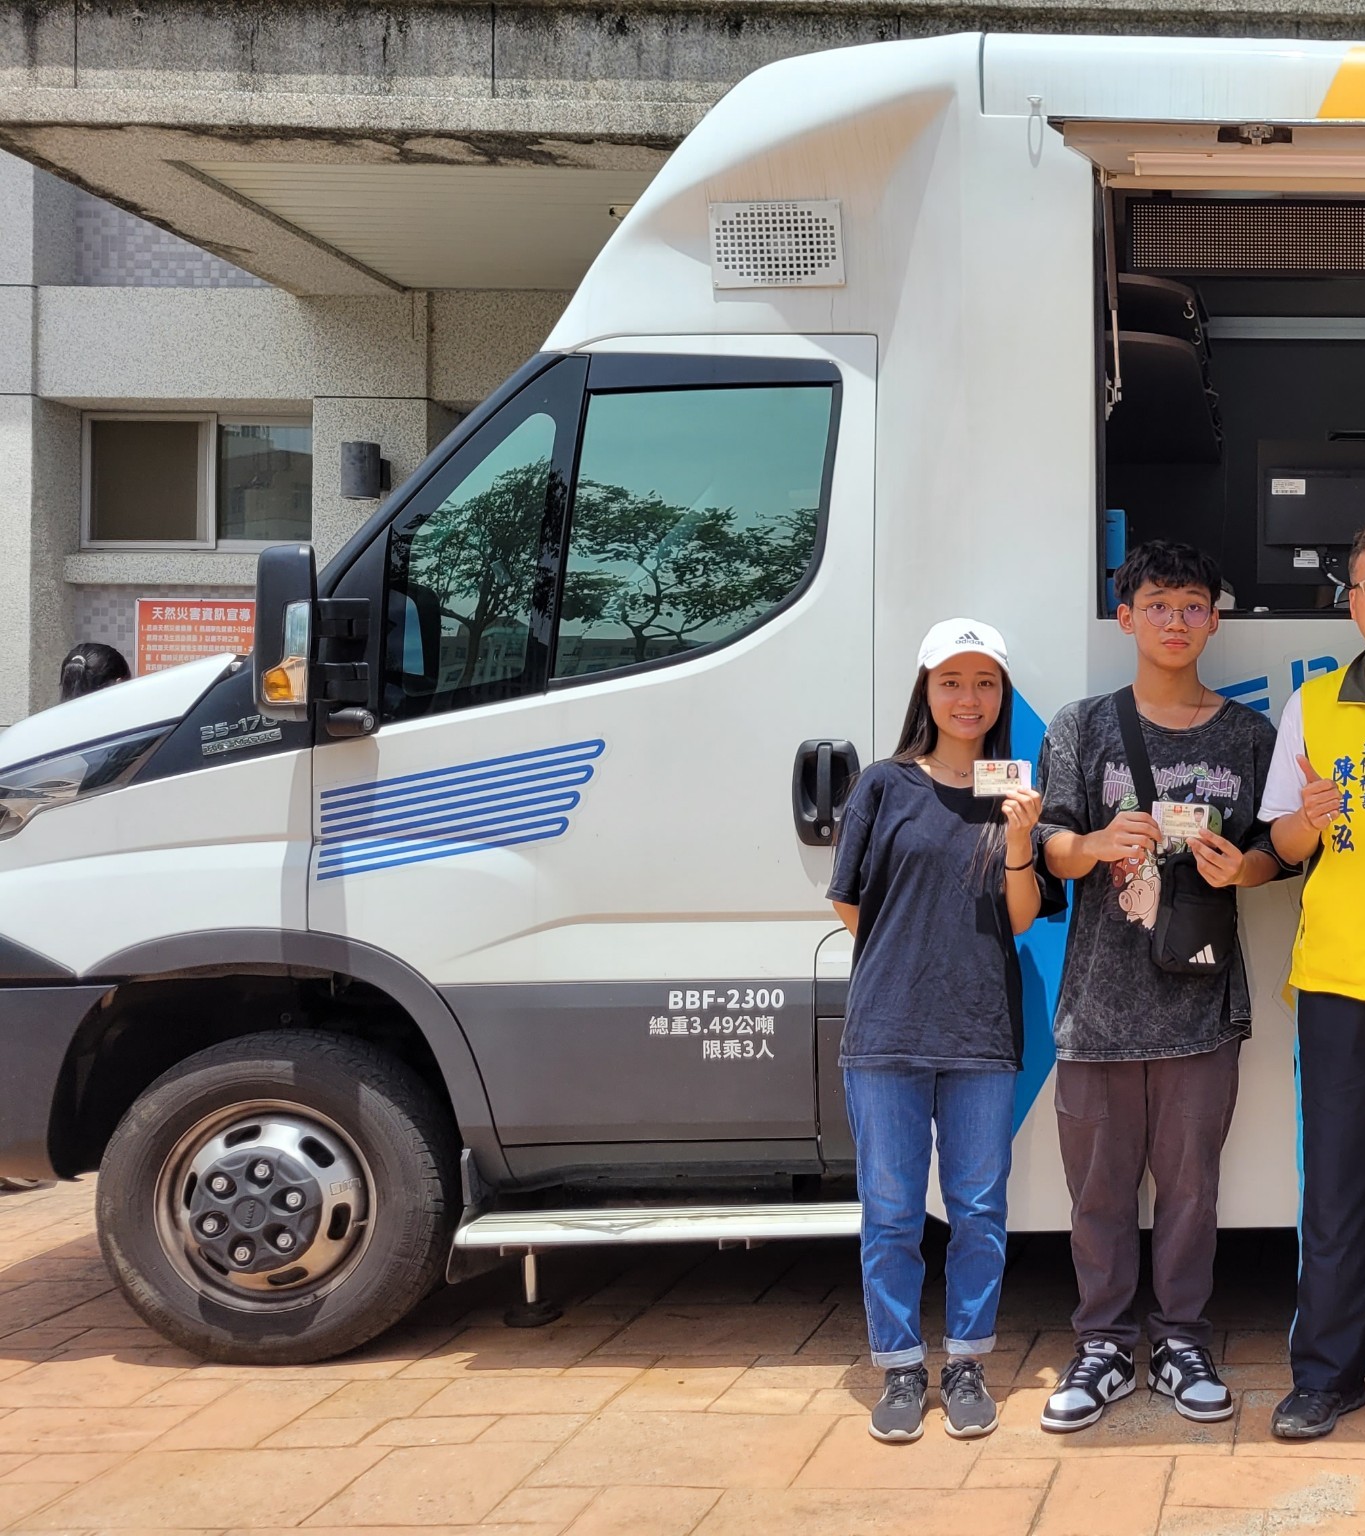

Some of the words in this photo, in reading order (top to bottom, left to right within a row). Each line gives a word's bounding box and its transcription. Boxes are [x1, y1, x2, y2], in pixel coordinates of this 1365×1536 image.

[151, 606, 251, 621] 天然災害資訊宣導
[955, 638, 985, 646] adidas
[199, 714, 278, 741] 35-170
[668, 988, 785, 1010] BBF-2300
[648, 1015, 775, 1036] 總重3.49公噸
[702, 1039, 775, 1060] 限乘3人
